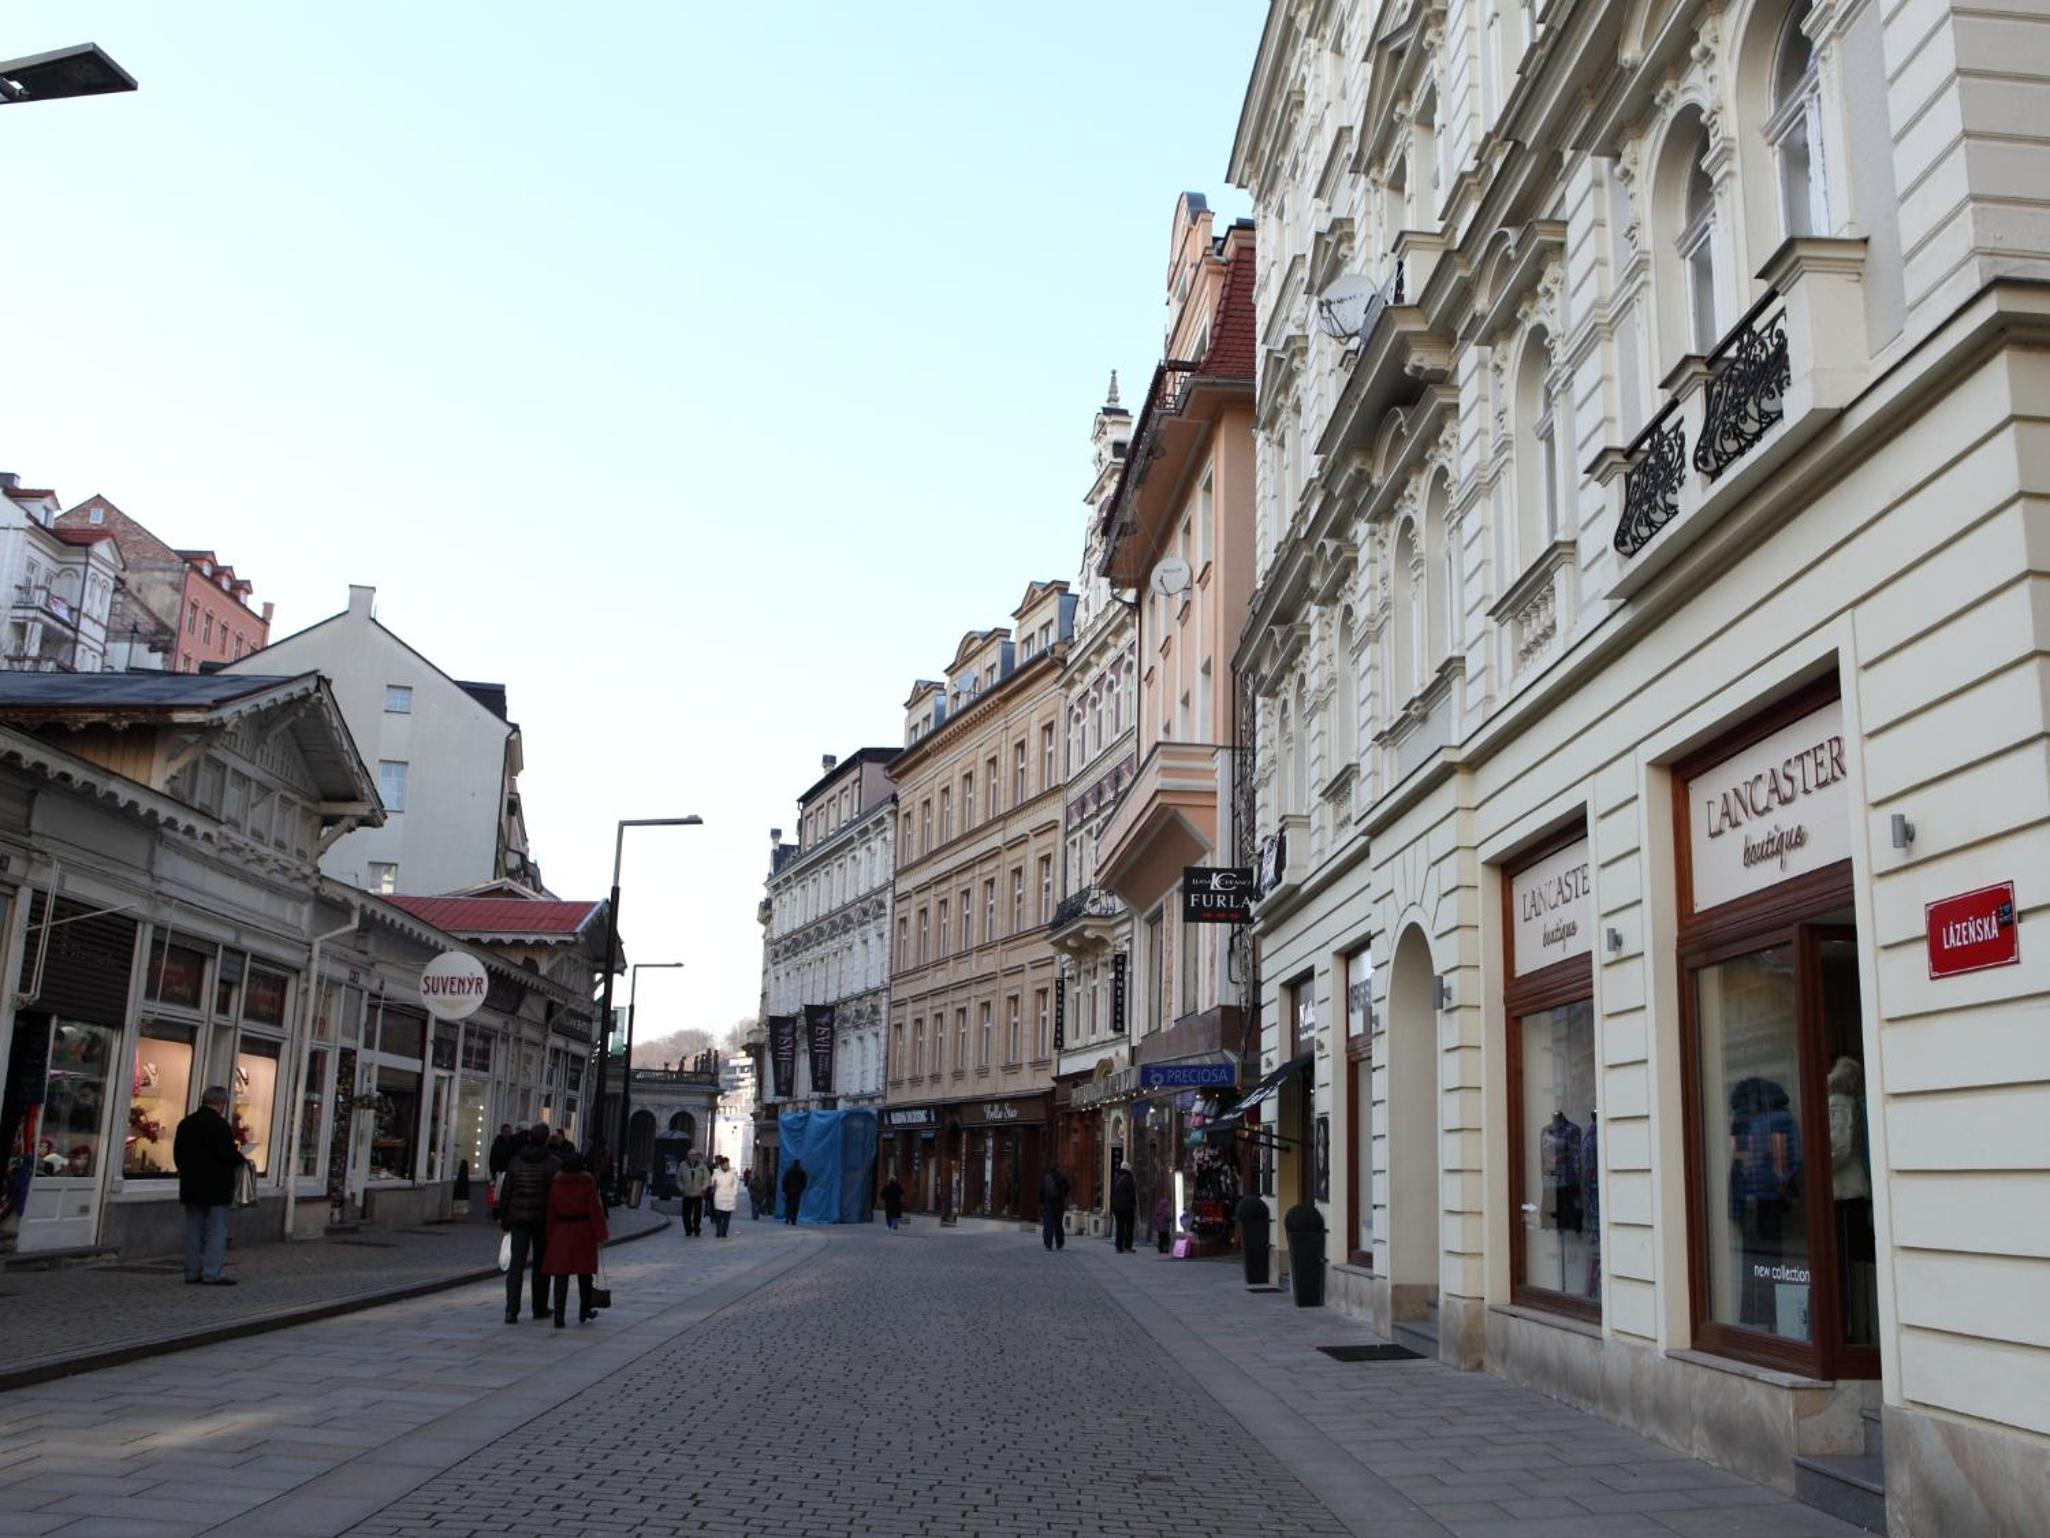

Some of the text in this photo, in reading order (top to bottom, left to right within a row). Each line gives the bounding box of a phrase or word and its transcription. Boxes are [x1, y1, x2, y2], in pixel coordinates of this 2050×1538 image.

[1706, 735, 1847, 840] LANCASTER
[1743, 824, 1808, 872] boutique
[1190, 893, 1250, 909] FURLA
[1542, 918, 1578, 953] boutique
[1942, 910, 1999, 950] LÁZEŇSKÁ
[1167, 1068, 1229, 1083] PRECIOSA
[1754, 1264, 1810, 1283] new collection
